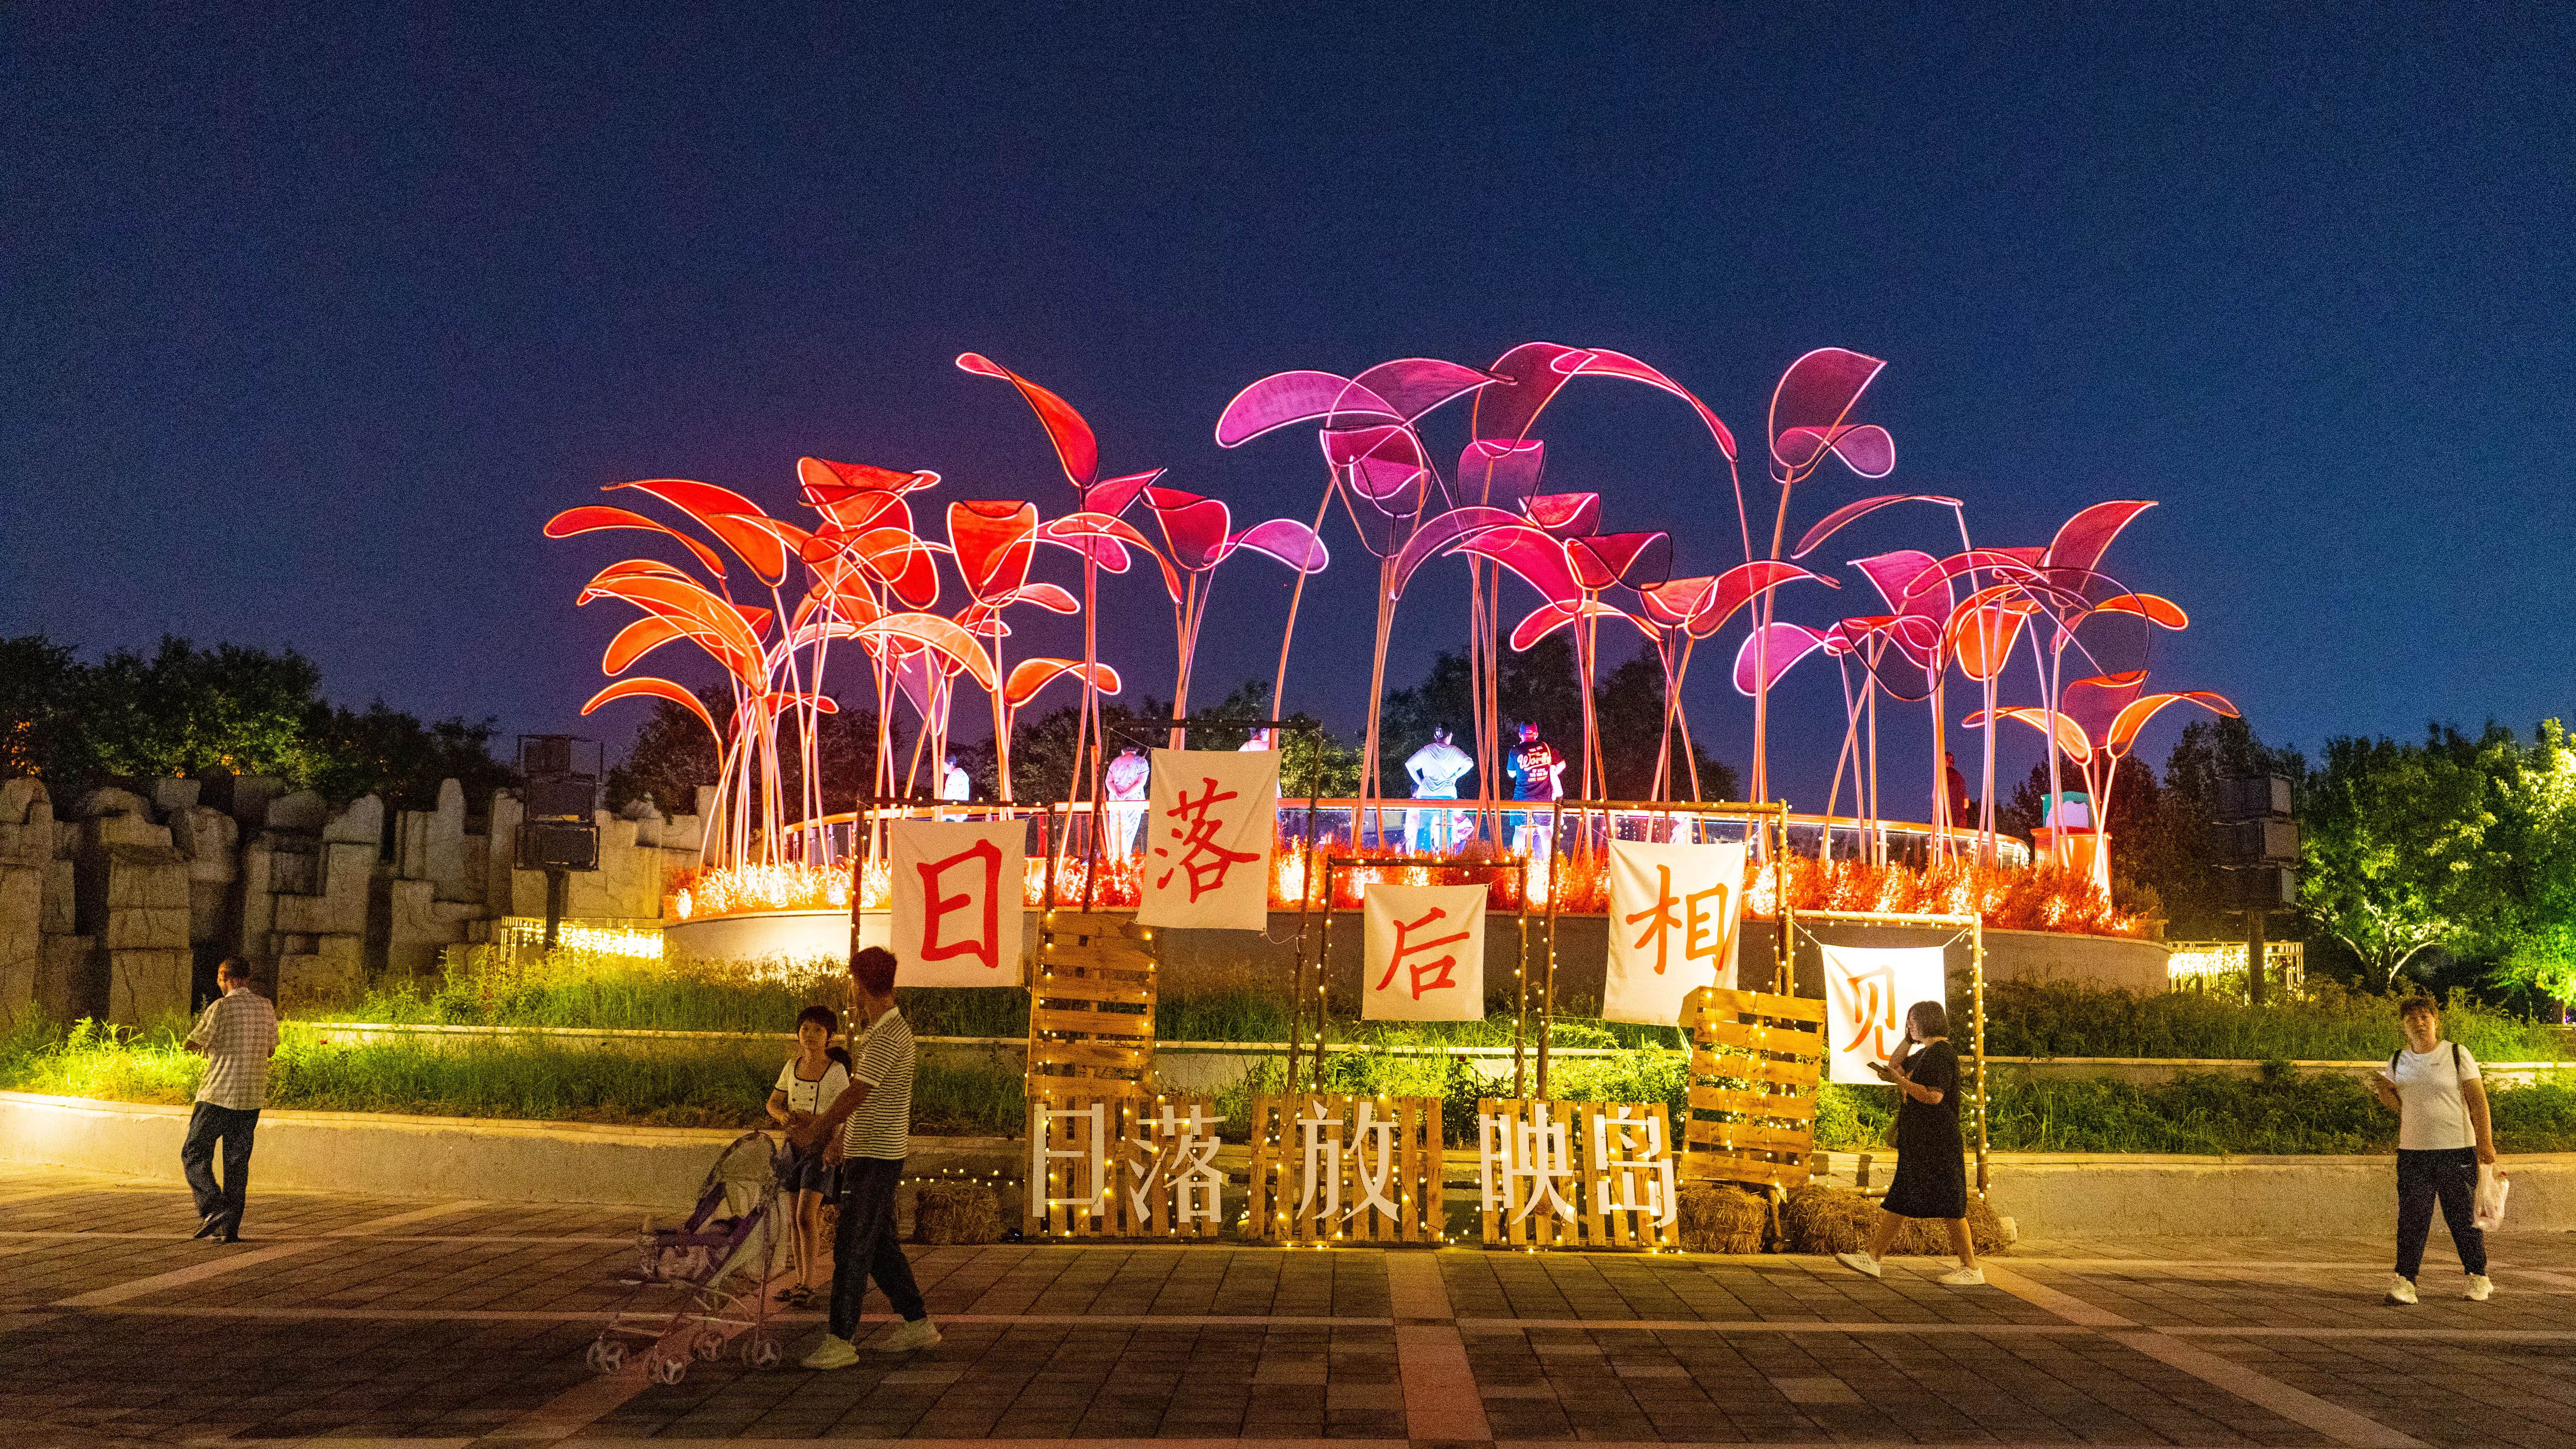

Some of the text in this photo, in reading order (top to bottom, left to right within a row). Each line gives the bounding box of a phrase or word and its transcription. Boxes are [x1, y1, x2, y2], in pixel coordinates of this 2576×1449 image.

[1154, 777, 1261, 903] 落
[917, 839, 1002, 968] 日
[1376, 907, 1470, 1000] 后
[1626, 864, 1728, 975] 相
[1843, 965, 1895, 1061] 见
